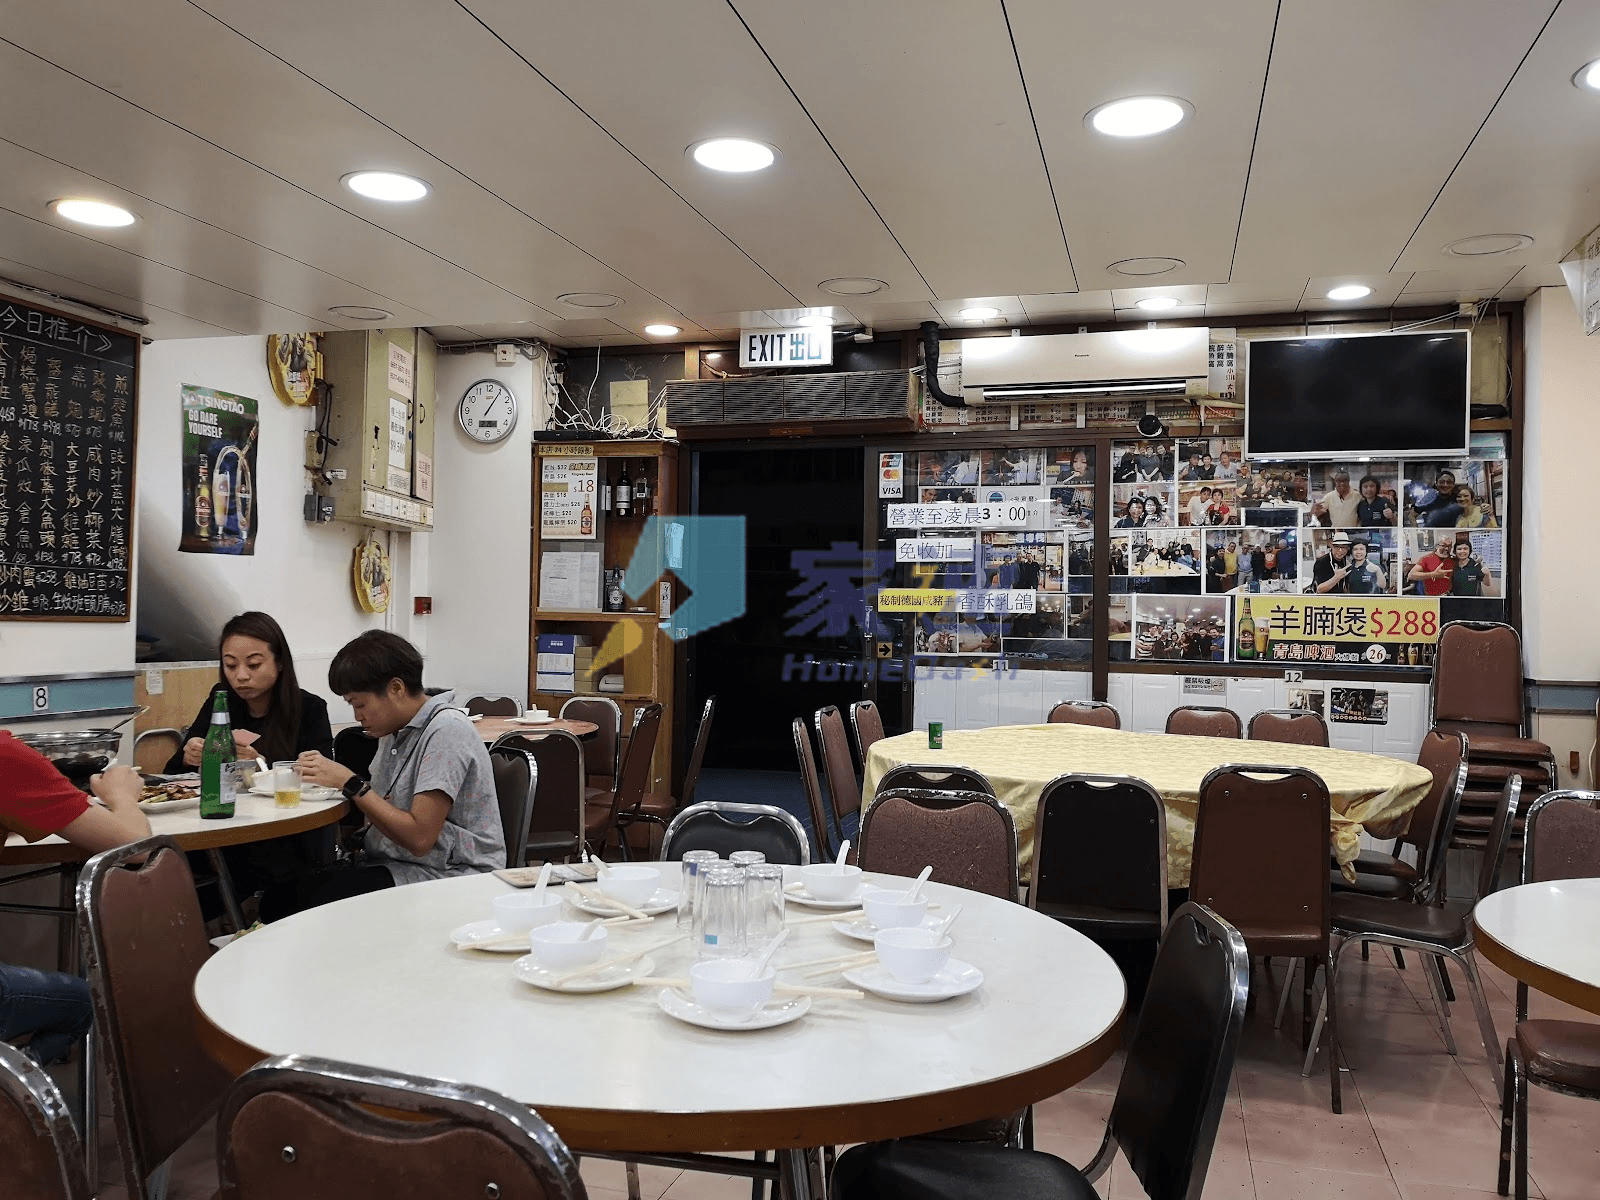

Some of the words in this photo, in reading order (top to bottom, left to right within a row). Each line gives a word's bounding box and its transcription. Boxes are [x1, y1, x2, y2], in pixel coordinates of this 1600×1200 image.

[749, 334, 786, 362] EXIT
[790, 333, 822, 361] 出口
[197, 394, 245, 414] TSINGTAO
[188, 409, 199, 421] GO
[200, 410, 218, 425] DARE
[188, 421, 223, 438] YOURSELF
[882, 487, 902, 495] VISA
[898, 541, 972, 560] 免收加一
[959, 593, 1034, 612] 香酥乳鴿
[1270, 604, 1367, 638] 羊腩煲
[1370, 606, 1438, 639] $288
[1272, 642, 1336, 661] 青島啤酒
[1369, 648, 1384, 660] 26
[993, 661, 1008, 671] 11
[1285, 672, 1302, 683] 12
[35, 687, 47, 708] 8
